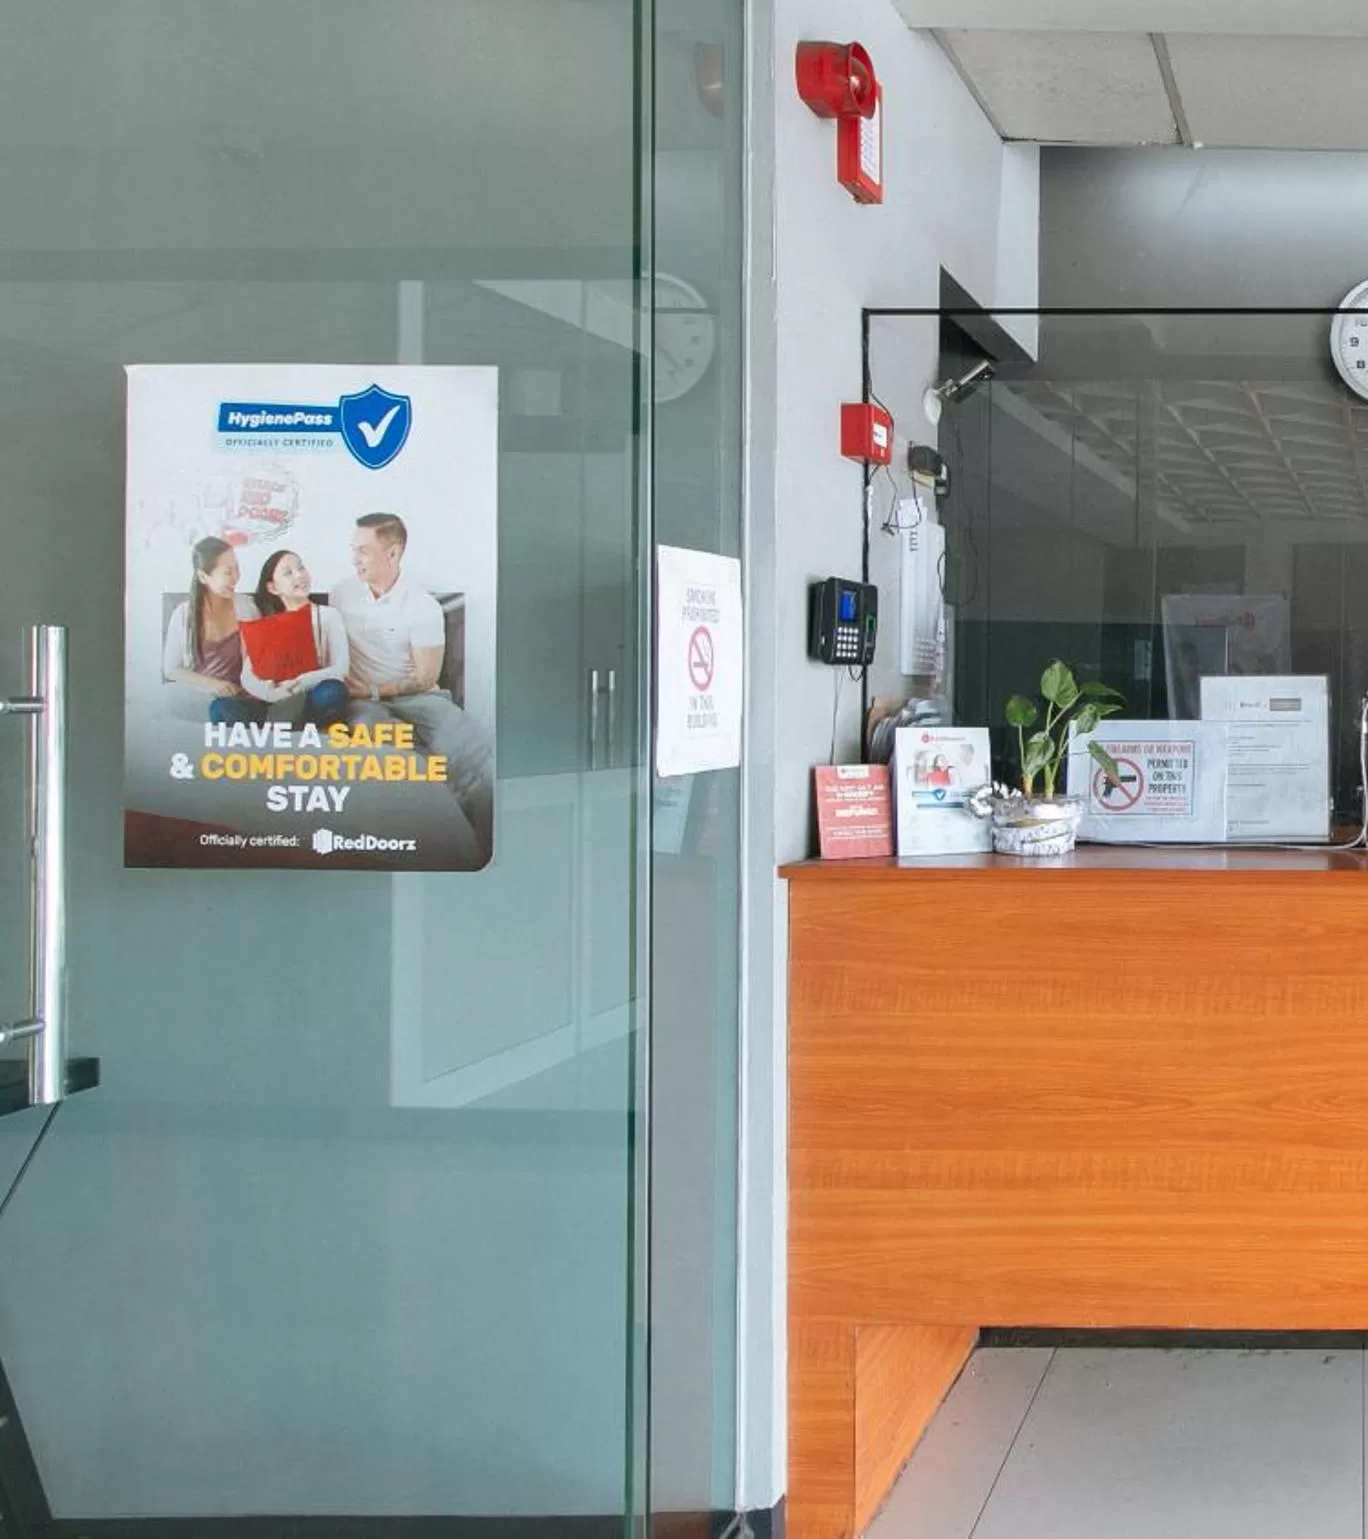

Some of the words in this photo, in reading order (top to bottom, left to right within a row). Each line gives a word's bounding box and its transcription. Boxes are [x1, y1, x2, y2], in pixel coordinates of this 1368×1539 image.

[1349, 336, 1360, 347] 9
[1356, 359, 1366, 369] 8
[227, 410, 333, 428] HygienePass
[281, 438, 334, 447] CERTIFIED
[203, 722, 293, 748] HAVE
[299, 722, 322, 748] A
[328, 723, 414, 749] SAFE
[169, 753, 195, 780] &
[201, 753, 448, 782] COMFORTABLE
[1147, 759, 1188, 769] PERMITTED
[1148, 783, 1187, 794] PROPERTY
[266, 786, 351, 812] STAY
[200, 834, 247, 849] Officially
[250, 834, 300, 847] certified:
[333, 833, 417, 850] RedDoorz
